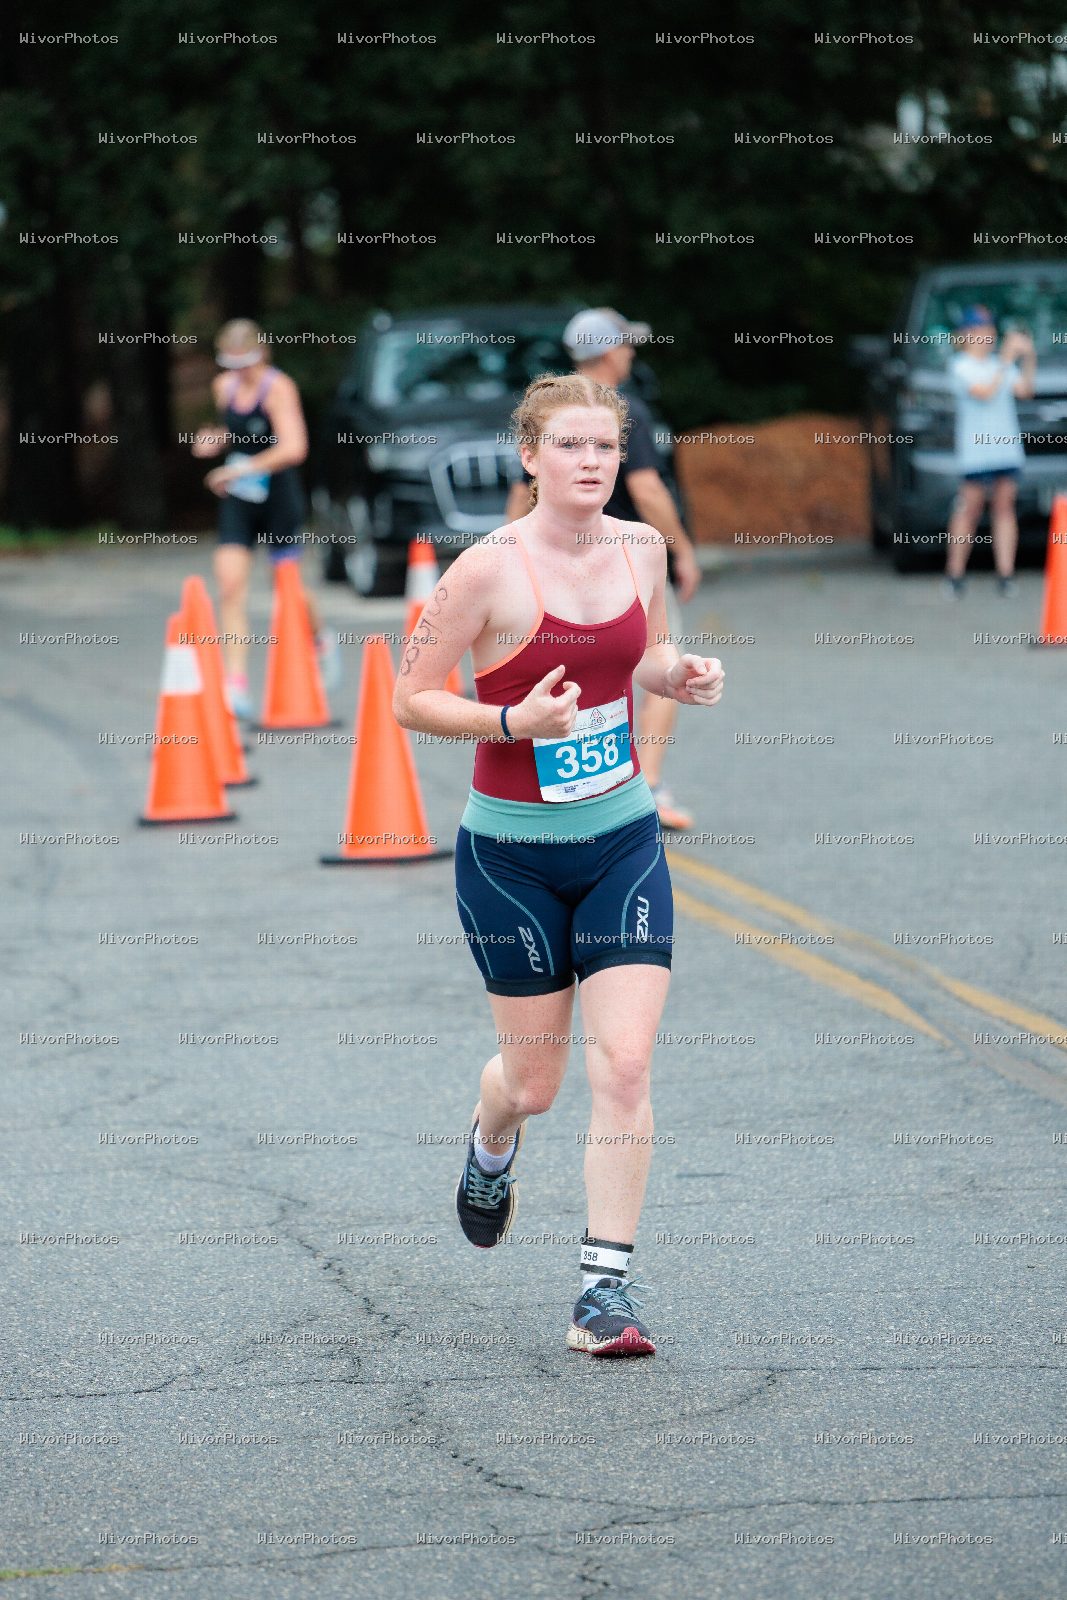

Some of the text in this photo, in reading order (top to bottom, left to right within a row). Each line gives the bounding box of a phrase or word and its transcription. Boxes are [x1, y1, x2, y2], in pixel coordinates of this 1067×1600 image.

[400, 587, 448, 676] 358
[555, 733, 619, 778] 358
[636, 895, 650, 942] 2XU
[518, 926, 543, 973] 2XU
[583, 1250, 598, 1262] 358
